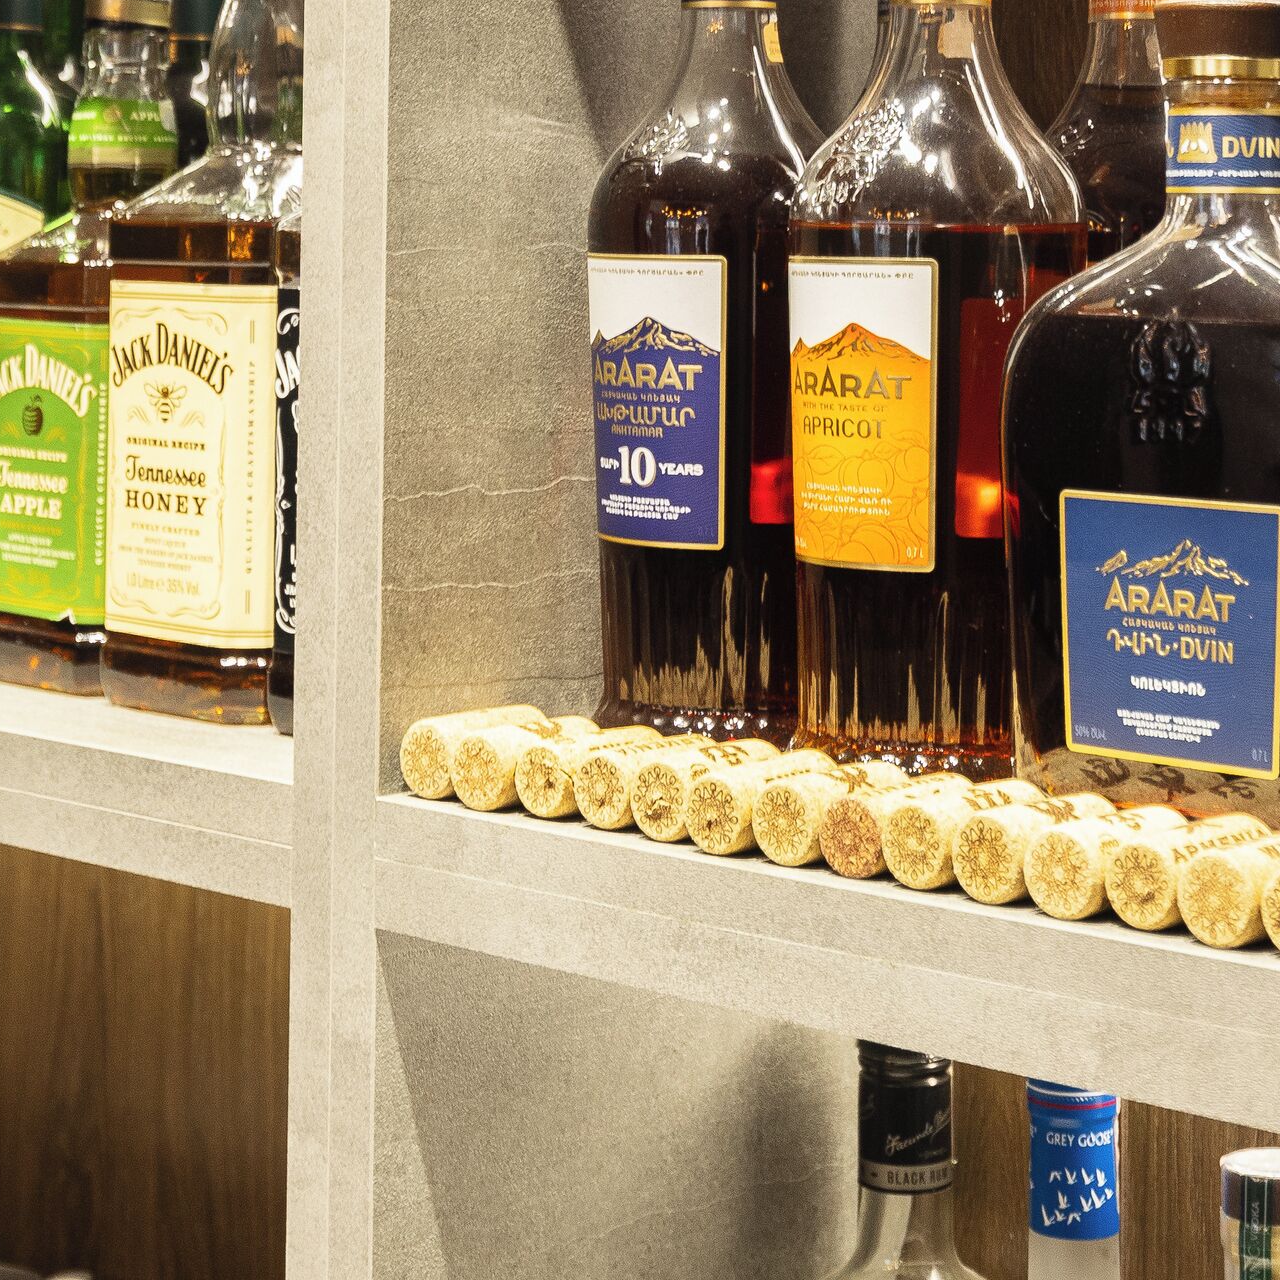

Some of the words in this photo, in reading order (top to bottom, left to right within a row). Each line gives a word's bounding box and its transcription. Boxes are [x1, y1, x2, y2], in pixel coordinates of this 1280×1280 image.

[1221, 135, 1280, 160] DVIN
[111, 333, 155, 388] JACK
[155, 322, 235, 396] DANIEL'S
[594, 352, 703, 391] ARARAT
[24, 342, 98, 418] DANIEL'S
[794, 365, 912, 400] ARARAT
[819, 402, 835, 411] THE
[838, 403, 868, 413] TASTE
[872, 404, 886, 413] OF
[126, 435, 169, 448] ORIGINAL
[611, 423, 664, 438] AKHTAMAR
[803, 415, 887, 440] APRICOT
[125, 454, 207, 488] Tennessee
[618, 445, 657, 488] 10
[658, 462, 705, 477] YEARS
[0, 492, 63, 520] APPLE
[125, 489, 207, 517] HONEY
[1104, 575, 1236, 623] ARARAT
[1180, 636, 1234, 665] DVIN
[1046, 1130, 1075, 1147] GREY
[887, 1170, 927, 1185] BLACK
